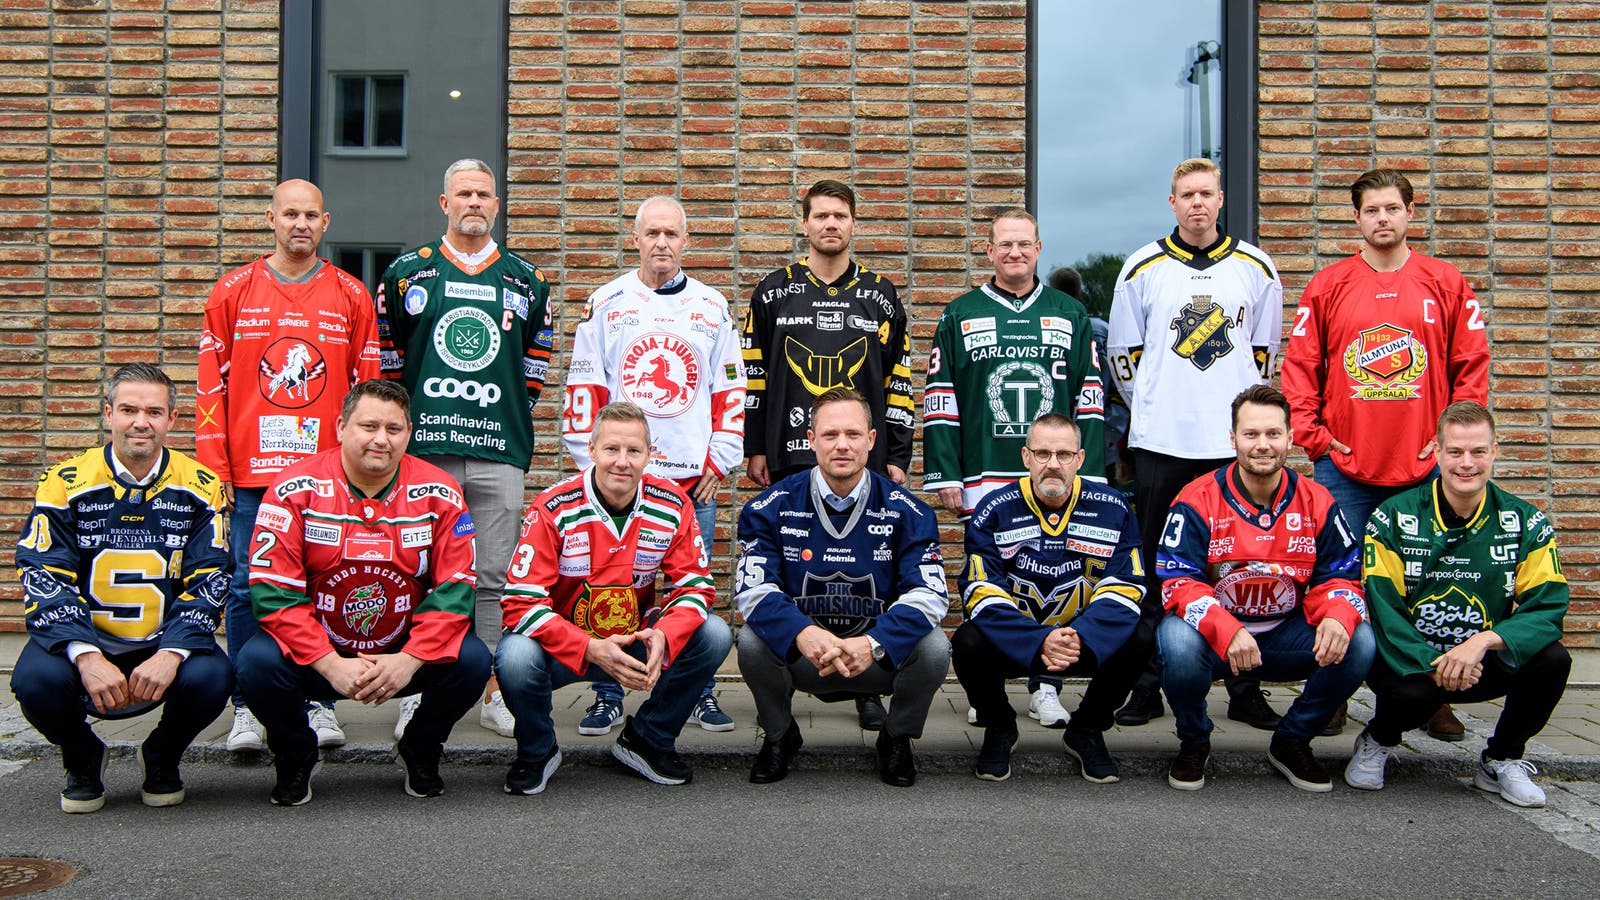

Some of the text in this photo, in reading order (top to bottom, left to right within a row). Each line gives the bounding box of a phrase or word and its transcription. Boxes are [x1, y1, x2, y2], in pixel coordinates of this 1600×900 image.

[448, 286, 494, 298] Assemblin
[444, 310, 494, 330] KRISTIANSTADS
[502, 310, 514, 332] C
[776, 316, 814, 326] MARK
[1423, 299, 1436, 324] C
[1466, 300, 1485, 330] 2
[318, 320, 346, 332] stadiu
[1293, 307, 1310, 336] 2
[440, 348, 493, 369] ISHOCKEYKLUBB
[971, 346, 1048, 362] CARLQVIST
[1360, 339, 1408, 365] ALMTUNA
[1390, 354, 1402, 368] S
[569, 366, 594, 374] ommun
[570, 359, 592, 367] ungby
[1052, 360, 1067, 380] C
[1111, 354, 1134, 382] 13
[624, 373, 636, 386] IF
[423, 377, 501, 408] coop
[1366, 390, 1404, 398] UPPSALA
[262, 417, 284, 428] Let's
[420, 413, 501, 431] Scandinavian
[261, 428, 292, 438] create
[415, 430, 506, 450] Glass Recycling
[262, 439, 316, 452] Norrköping
[974, 490, 1020, 528] FAGERHULT
[780, 526, 808, 538] Swegon
[1078, 526, 1119, 542] Liljedahl
[250, 531, 276, 568] 2
[693, 534, 708, 568] 3
[1066, 540, 1112, 556] Passera
[1208, 536, 1236, 548] OCKEY
[168, 550, 183, 578] A
[512, 543, 536, 578] 3
[823, 554, 856, 562] Helmia
[326, 566, 407, 588] MODO HOCKEY
[90, 548, 168, 640] S
[826, 582, 853, 596] BIK
[1235, 580, 1280, 606] VIK
[316, 592, 336, 612] 19
[345, 598, 386, 612] MODO
[394, 594, 412, 613] 21
[794, 596, 884, 617] KARLSKOGA
[1224, 602, 1288, 616] HOCKEY
[1418, 601, 1484, 626] Björk
[1415, 618, 1480, 638] löven
[352, 640, 374, 650] 100
